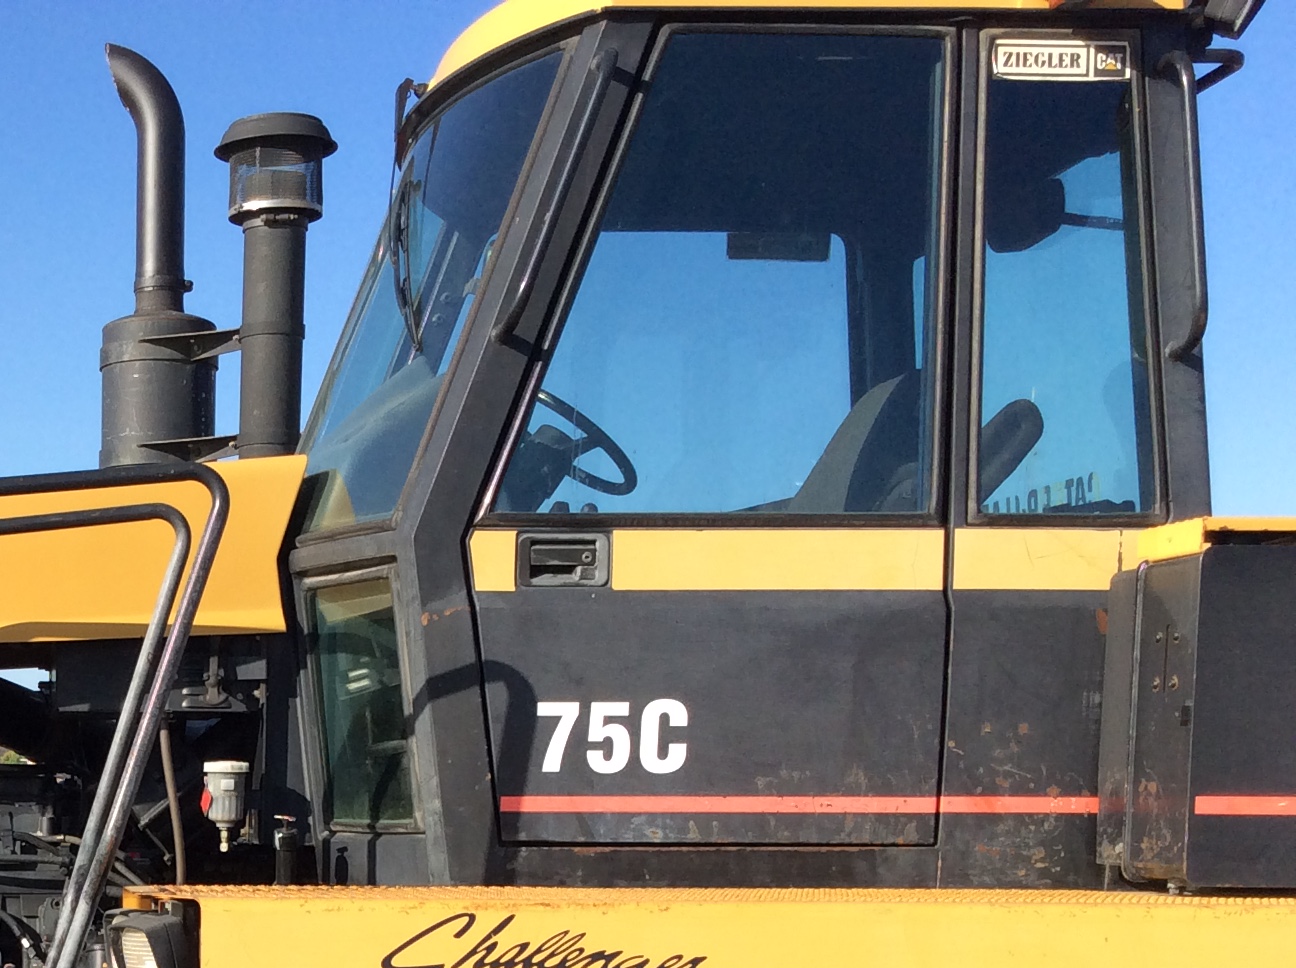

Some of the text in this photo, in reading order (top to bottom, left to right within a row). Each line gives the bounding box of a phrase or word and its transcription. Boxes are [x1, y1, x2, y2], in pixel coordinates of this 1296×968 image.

[1002, 52, 1124, 70] ZIEGLER CAT
[536, 698, 689, 775] 75C
